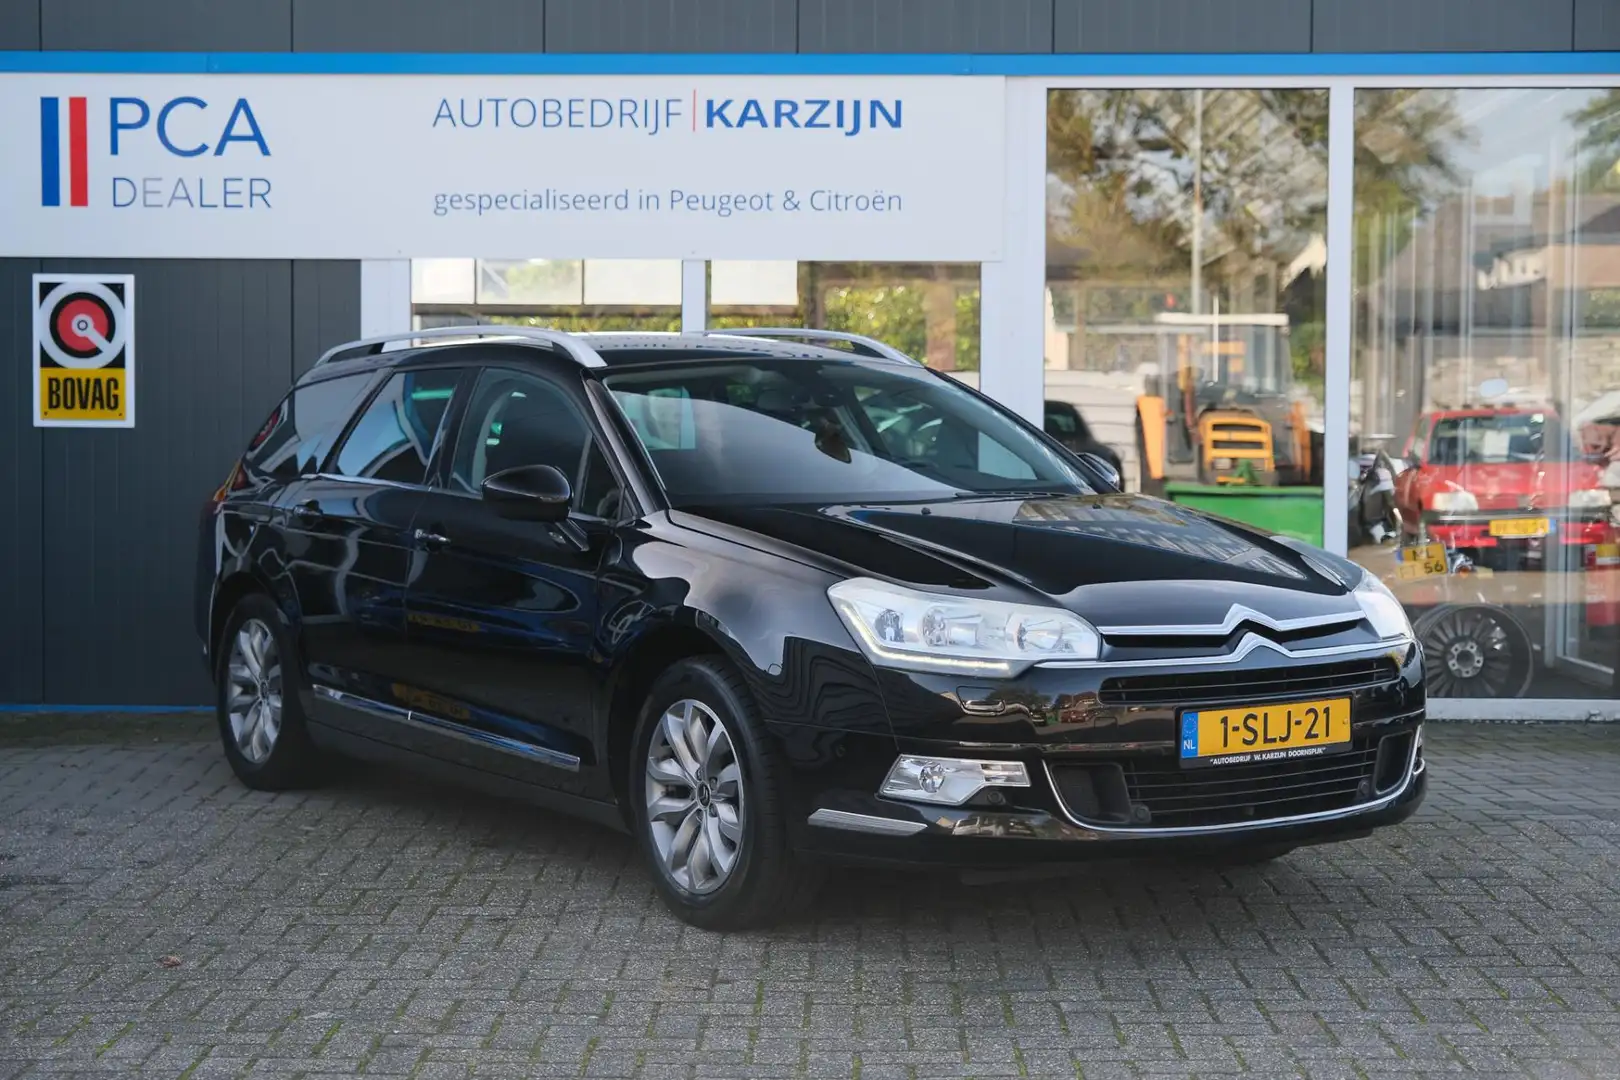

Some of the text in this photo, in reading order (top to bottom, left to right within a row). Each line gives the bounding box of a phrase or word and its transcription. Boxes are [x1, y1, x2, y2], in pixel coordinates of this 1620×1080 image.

[110, 96, 271, 157] PCA
[432, 98, 902, 137] AUTOBEDRIJF KARZIJN
[112, 177, 272, 208] DEALER
[434, 189, 902, 217] gespecialiseerd in Peugeot & Citroën
[48, 377, 119, 410] BOVAG
[1220, 706, 1331, 748] 1-SLJ-21
[1183, 739, 1196, 750] NL
